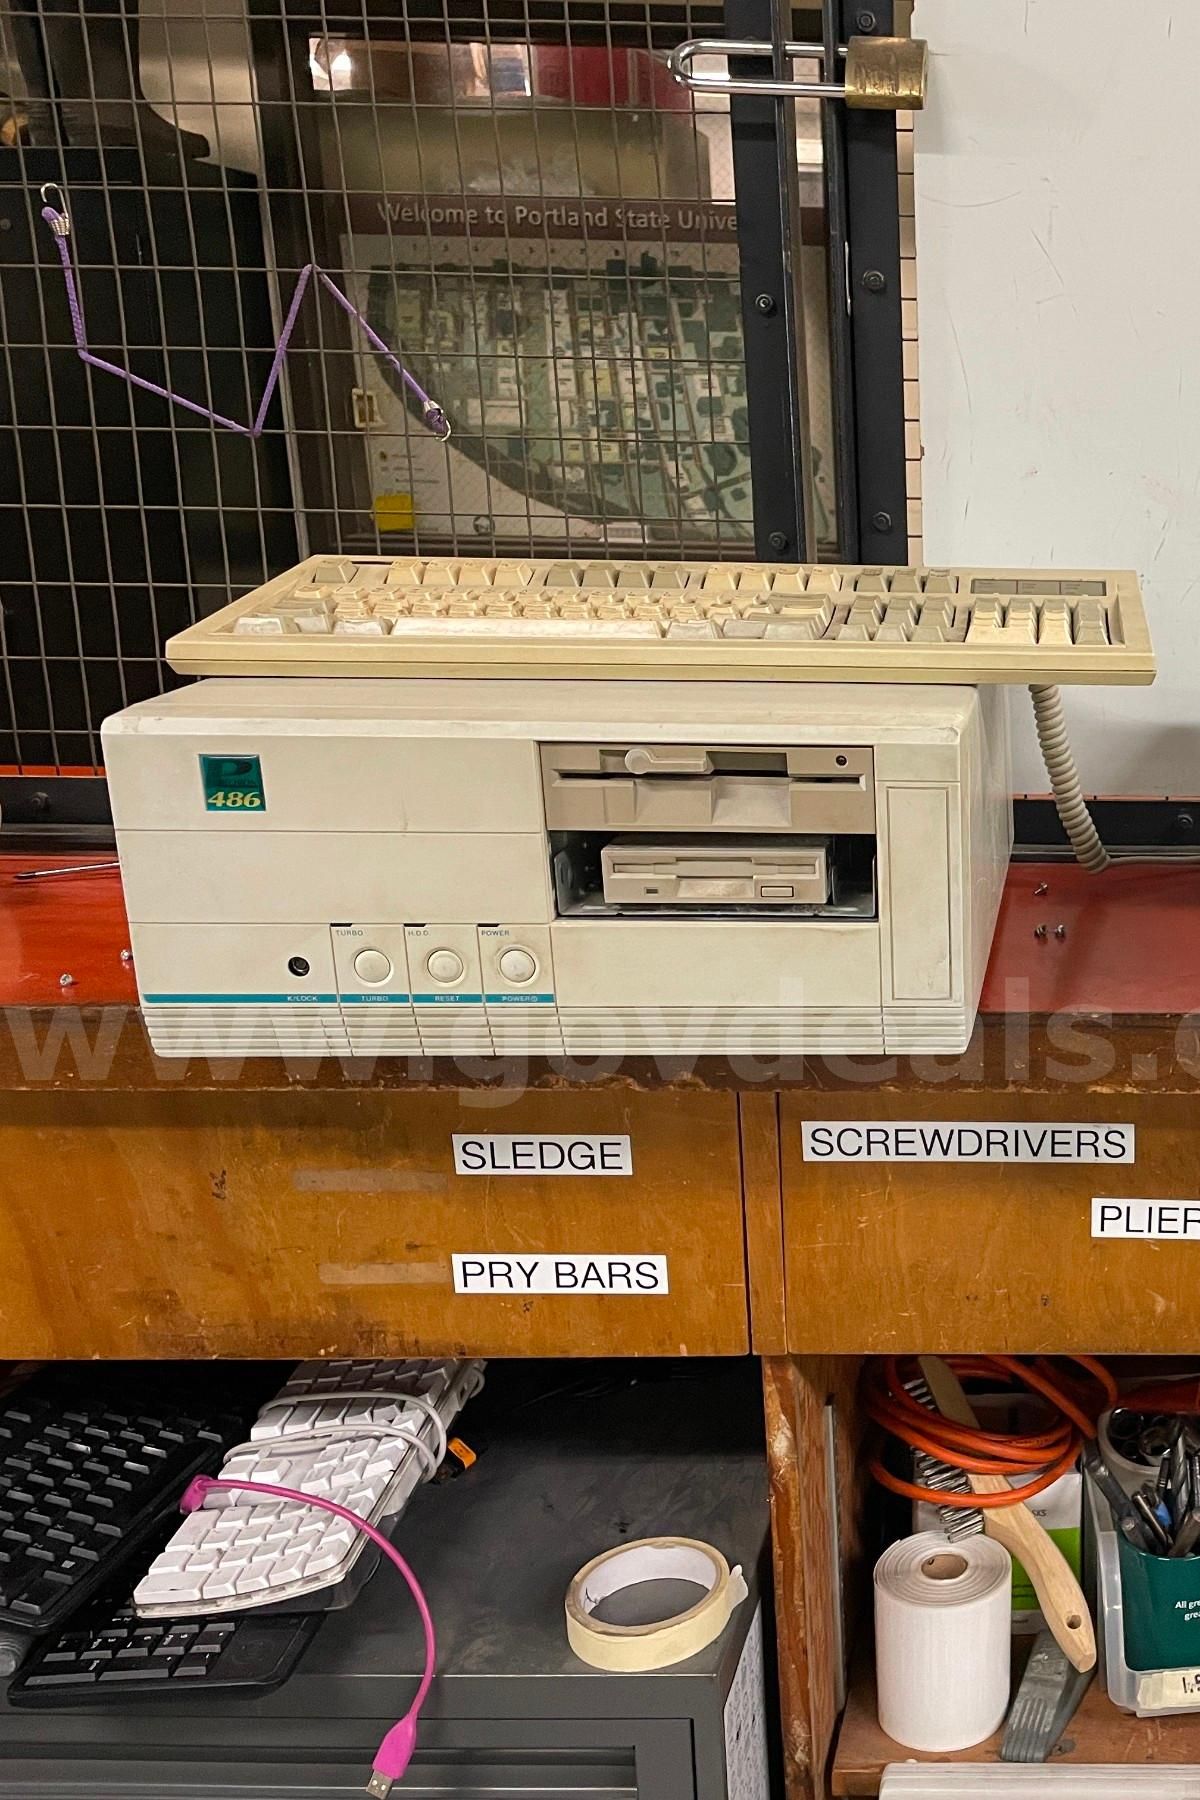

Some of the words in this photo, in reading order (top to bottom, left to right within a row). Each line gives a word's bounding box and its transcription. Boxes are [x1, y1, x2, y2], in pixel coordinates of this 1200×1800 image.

[377, 202, 478, 224] Welcome
[485, 204, 506, 225] to
[515, 204, 609, 228] Portland
[615, 207, 671, 230] State
[207, 791, 261, 808] 486
[335, 929, 364, 937] TURBO
[481, 929, 510, 937] POWER
[810, 1127, 1127, 1159] SCREWDRIVERS
[461, 1140, 624, 1171] SLEDGE
[461, 1260, 540, 1290] PRY
[554, 1261, 660, 1291] BARS
[1174, 1600, 1188, 1610] All
